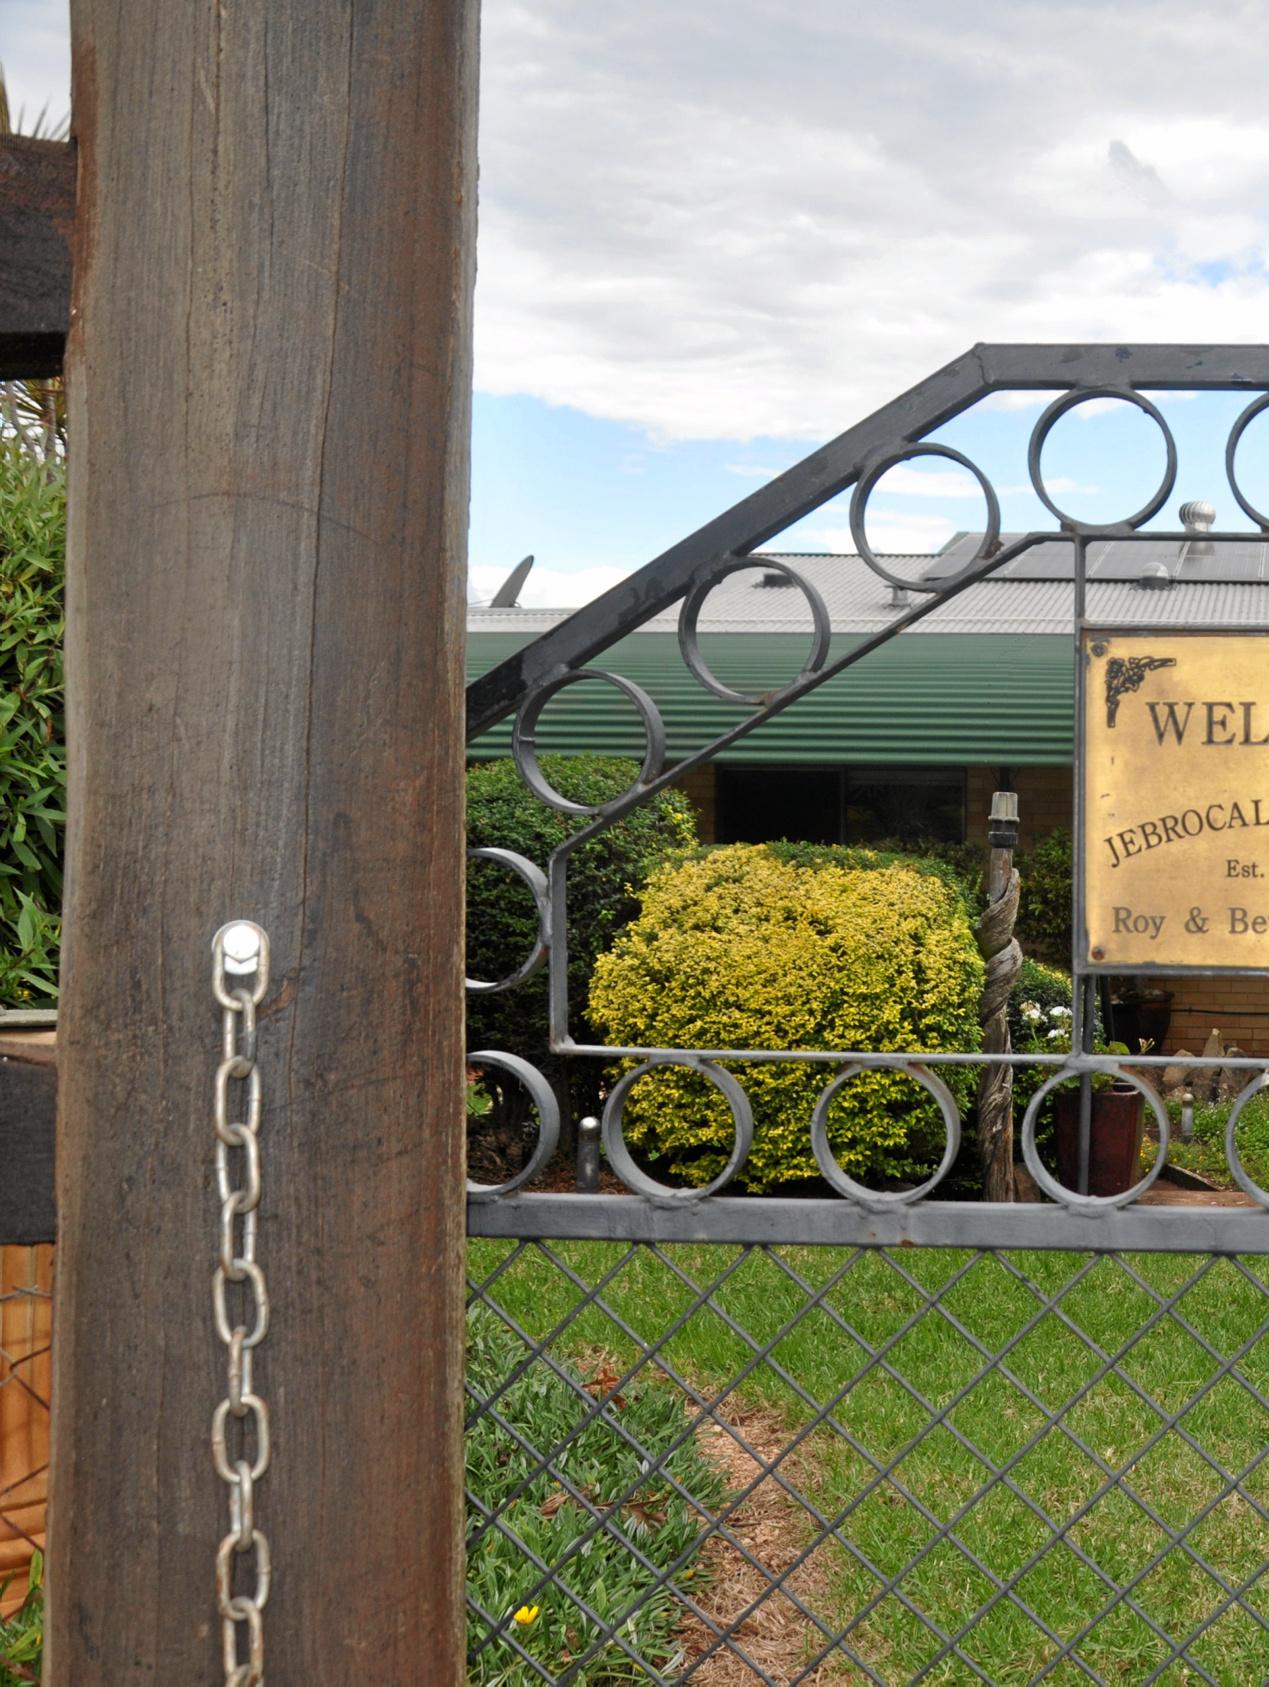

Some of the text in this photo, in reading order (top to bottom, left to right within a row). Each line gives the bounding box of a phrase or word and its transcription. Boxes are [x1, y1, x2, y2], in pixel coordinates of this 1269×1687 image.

[1226, 860, 1264, 878] Est.
[1112, 907, 1166, 939] Roy
[1185, 907, 1209, 934] &
